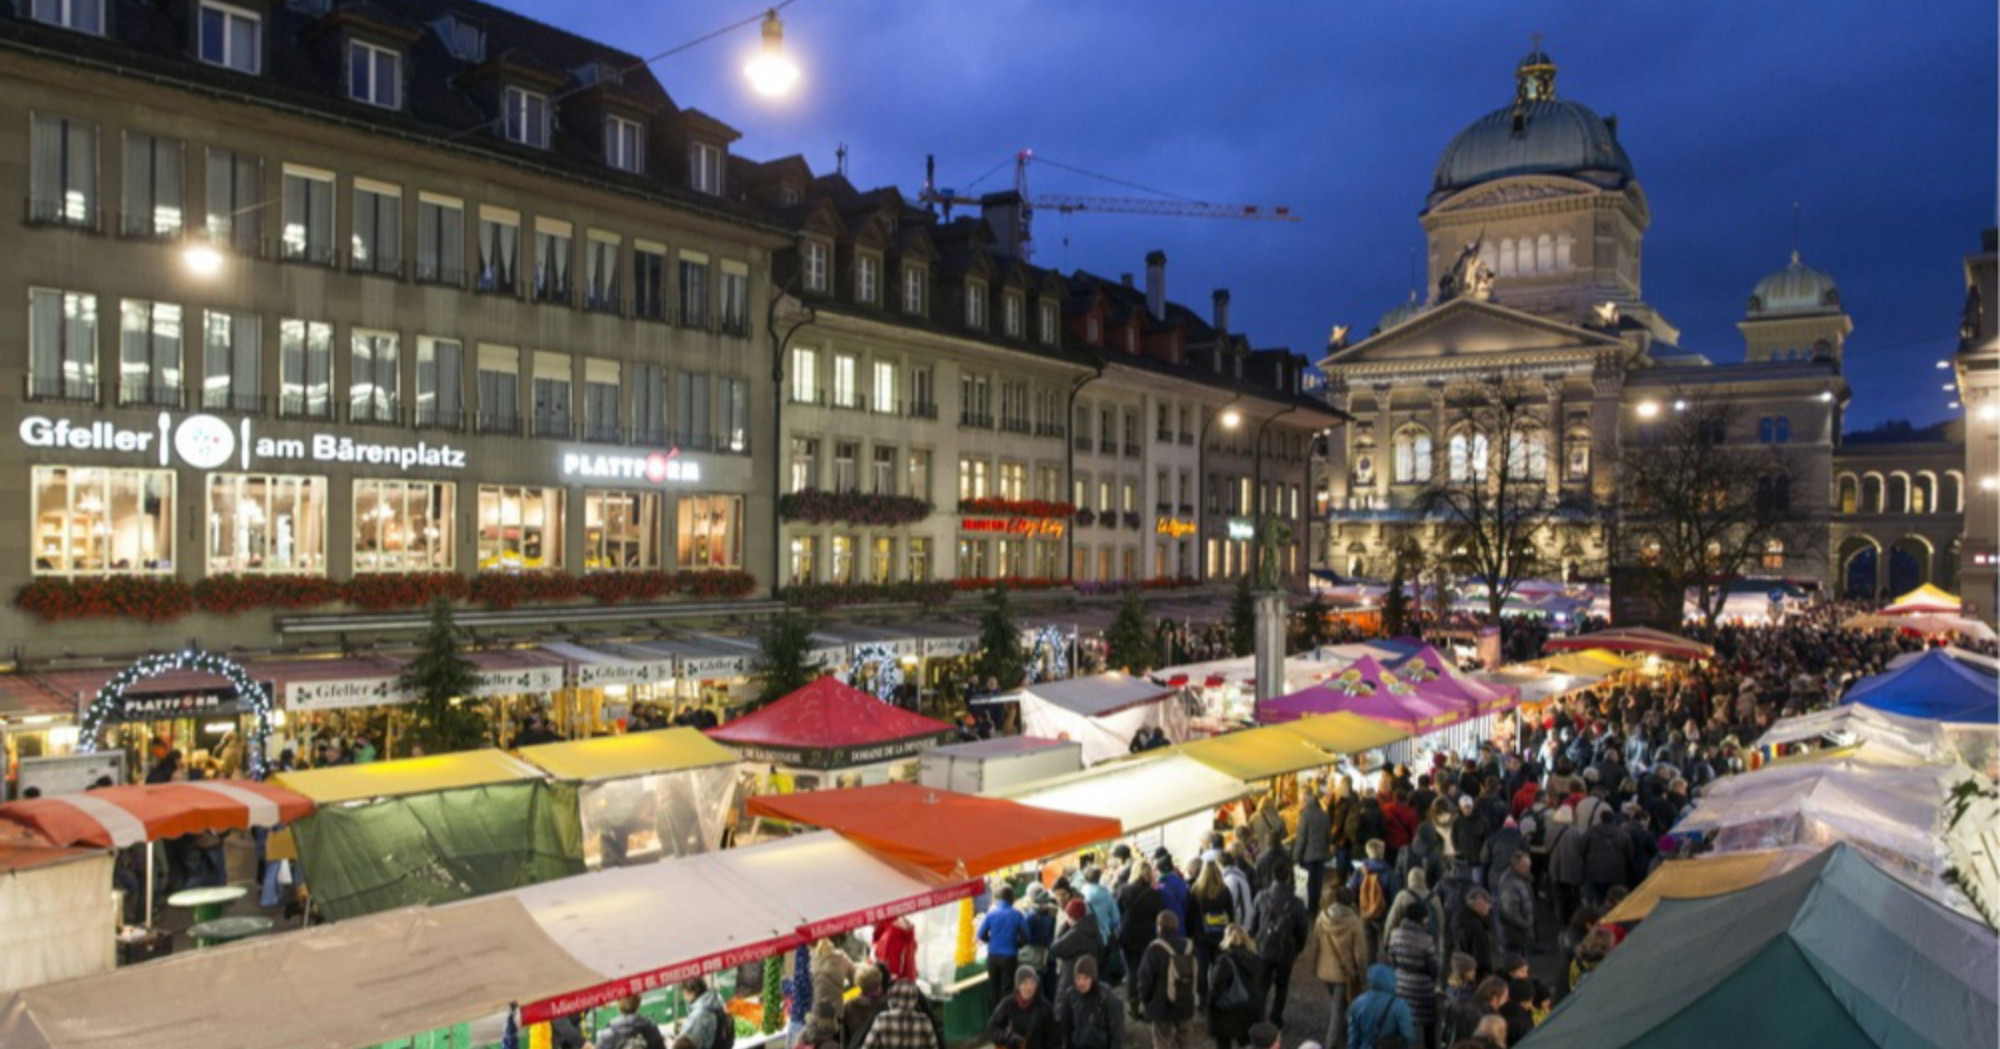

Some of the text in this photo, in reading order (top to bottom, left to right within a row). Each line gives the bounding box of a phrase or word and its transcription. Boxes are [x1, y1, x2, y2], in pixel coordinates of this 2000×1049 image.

[19, 415, 467, 470] Gfeller am Bärenplatz
[563, 451, 700, 484] PLATTFORM
[125, 694, 219, 712] PLATTFORM
[315, 683, 368, 698] Gfeller
[551, 986, 627, 1016] Mietservice
